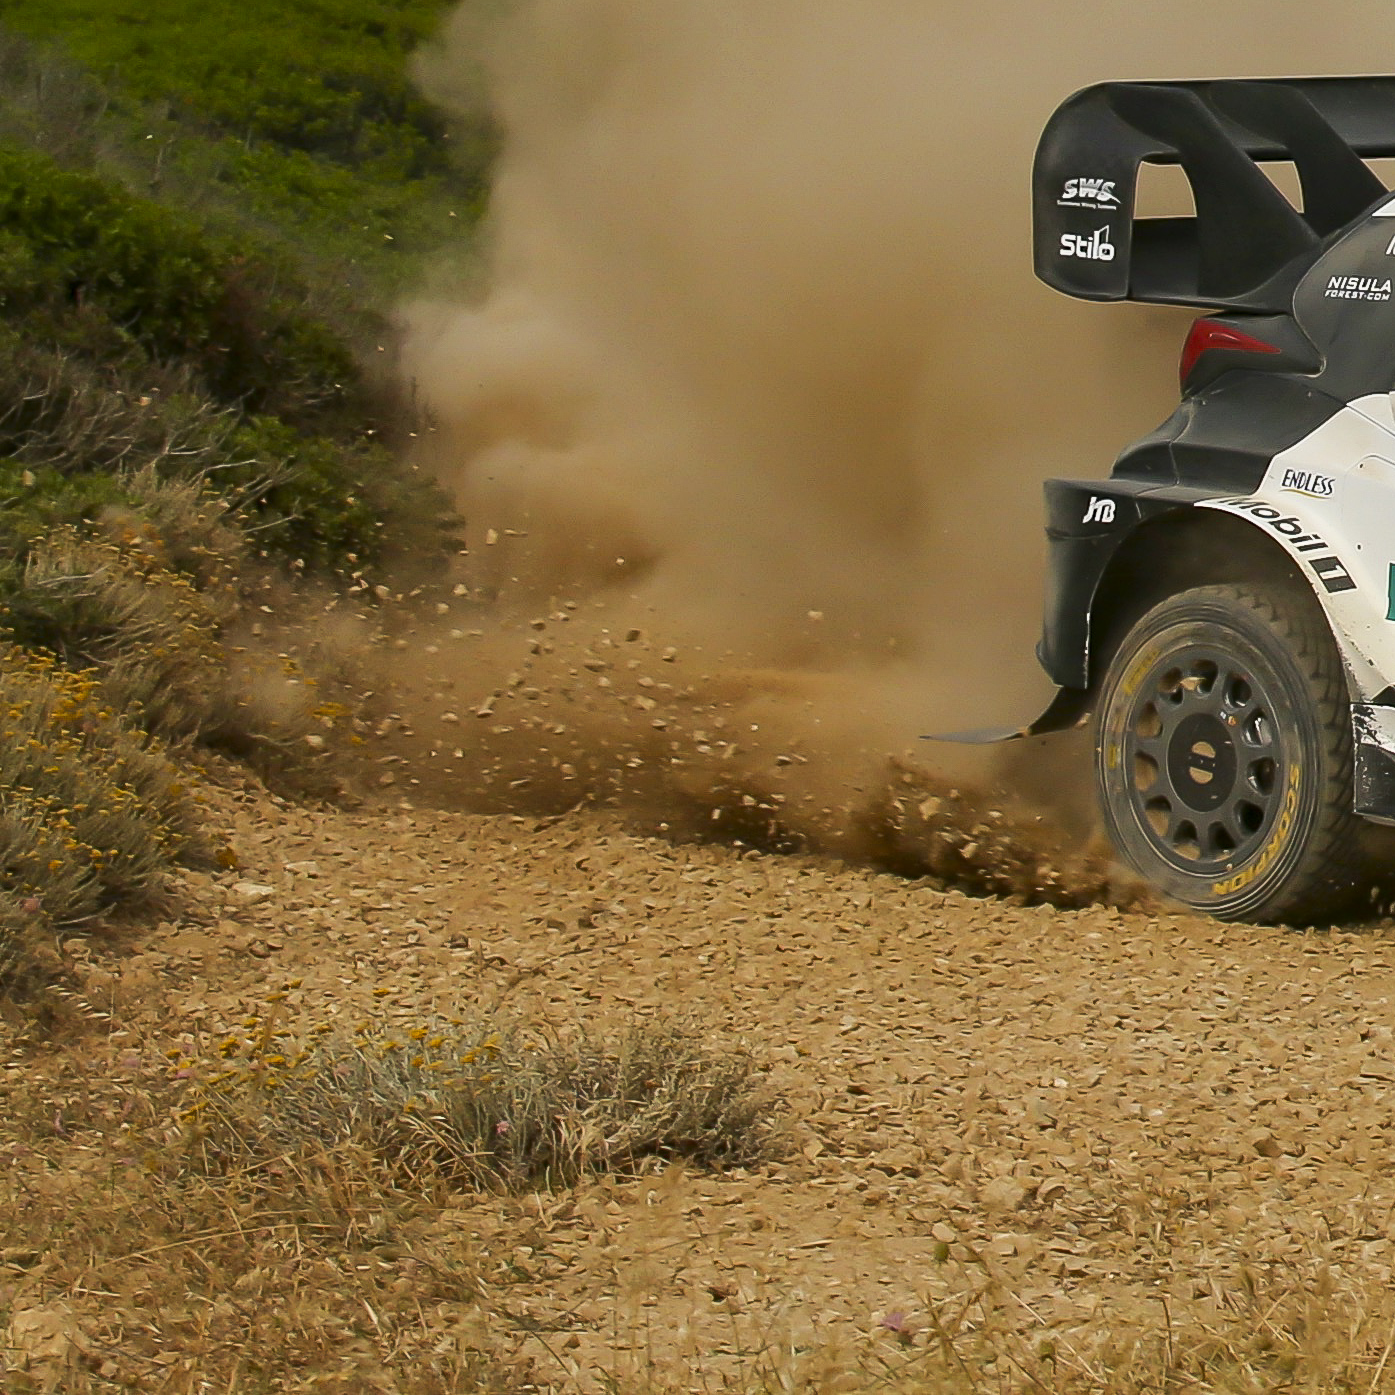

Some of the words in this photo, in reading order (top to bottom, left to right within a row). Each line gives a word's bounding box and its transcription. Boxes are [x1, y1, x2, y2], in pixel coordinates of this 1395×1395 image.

[1062, 178, 1121, 202] SWS
[1060, 225, 1115, 261] Stilo
[1327, 276, 1391, 293] NISULA
[1282, 469, 1336, 496] ENDLESS
